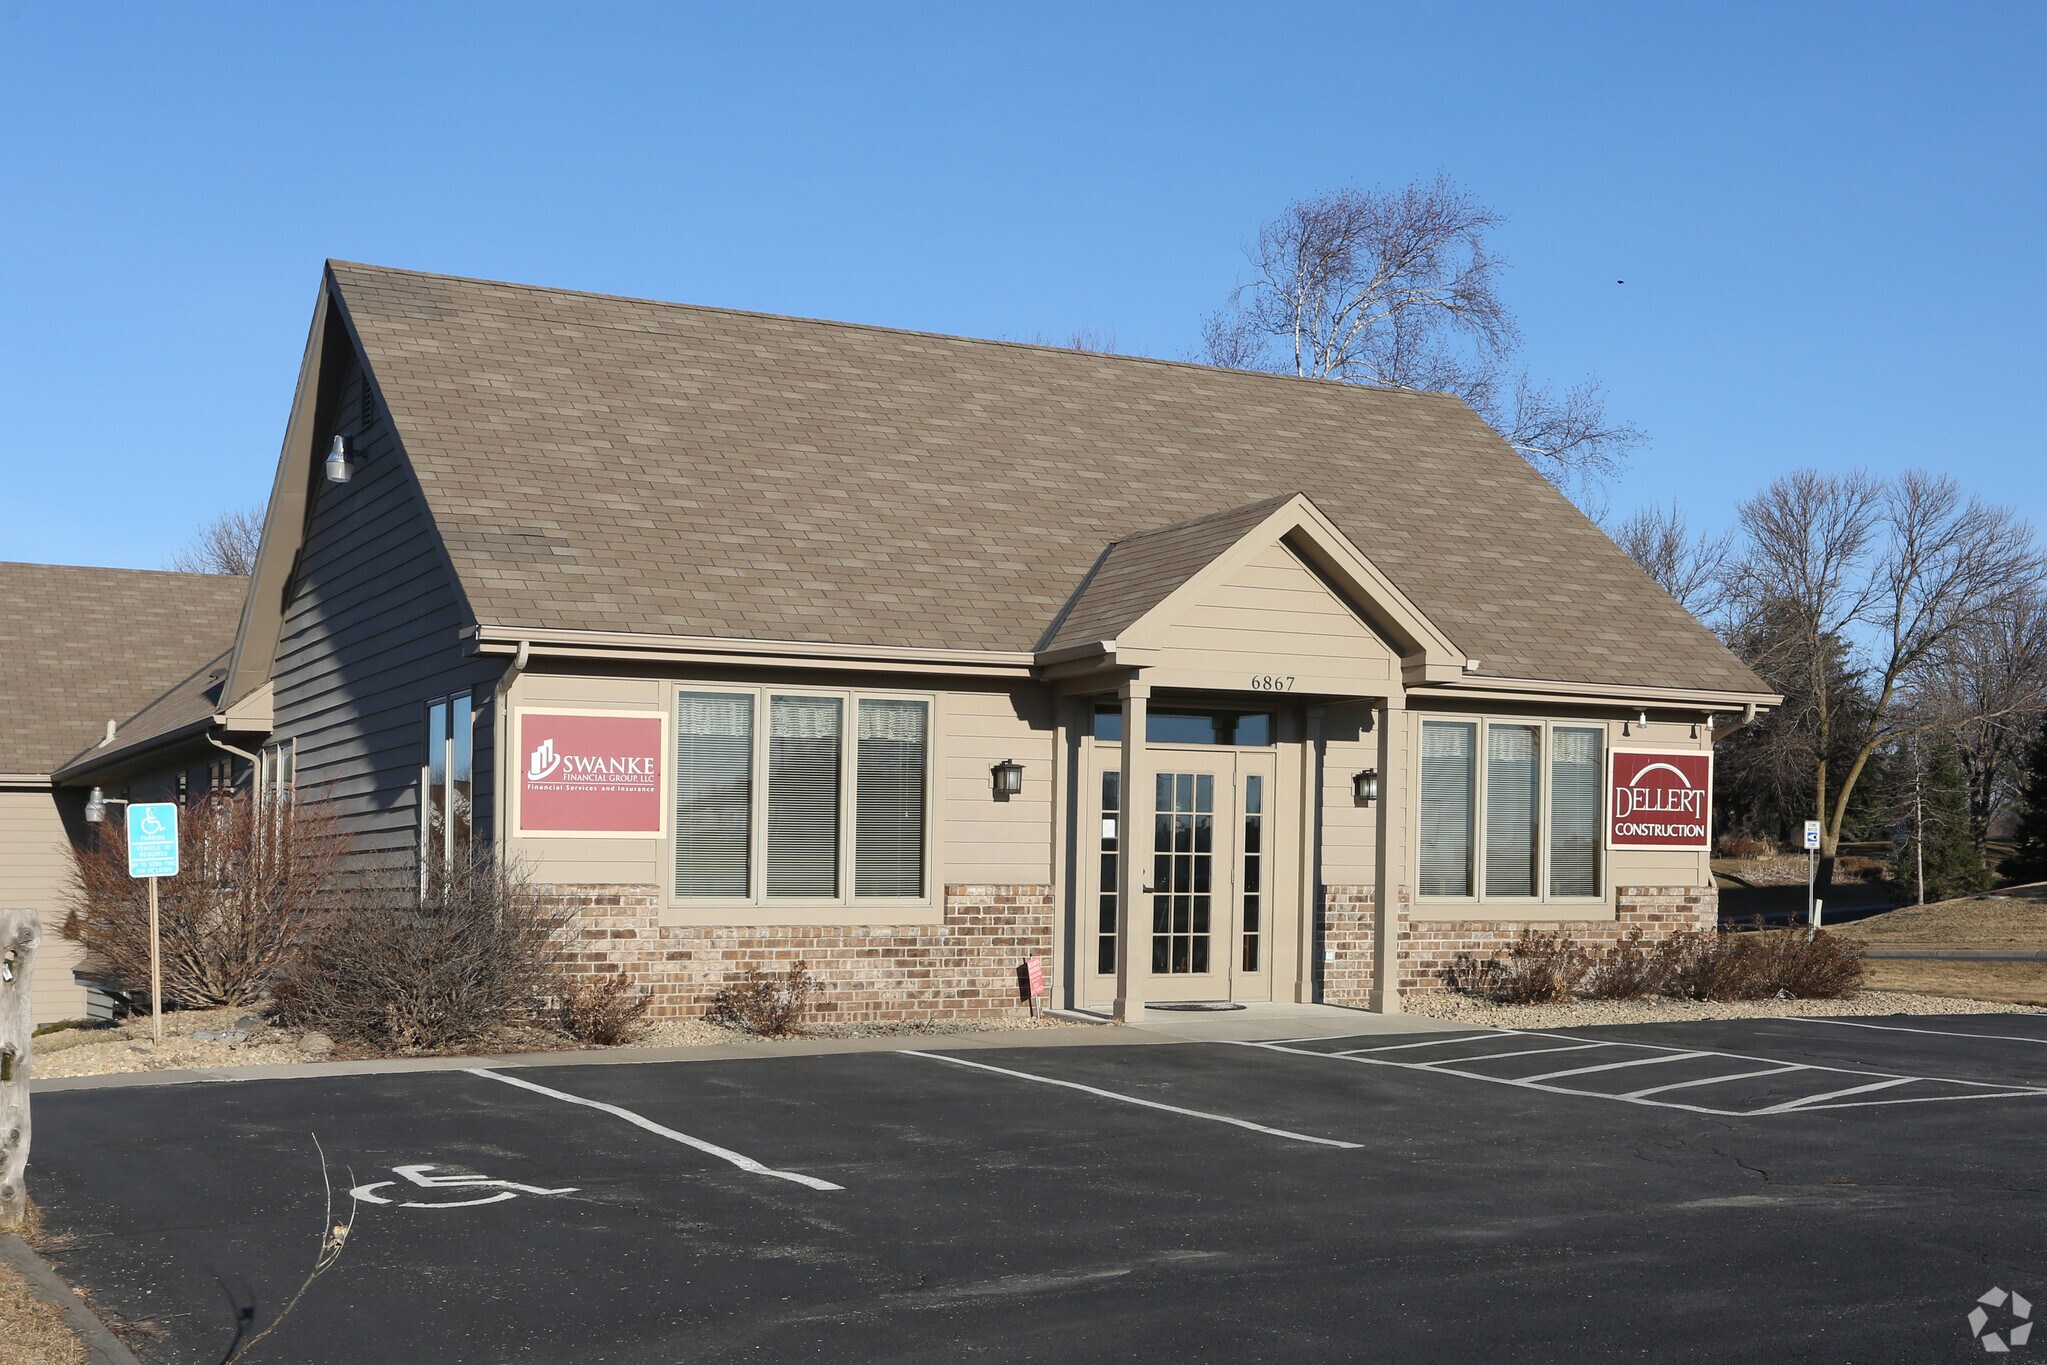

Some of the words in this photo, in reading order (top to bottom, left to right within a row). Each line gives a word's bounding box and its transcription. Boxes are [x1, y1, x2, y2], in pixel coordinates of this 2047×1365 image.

[1251, 675, 1295, 691] 6867
[563, 755, 655, 774] SWANKE
[563, 773, 607, 782] FINANCIAL
[640, 774, 654, 783] LLC
[1615, 787, 1705, 818] DELLERT
[1615, 823, 1705, 837] CONSTRUCTION
